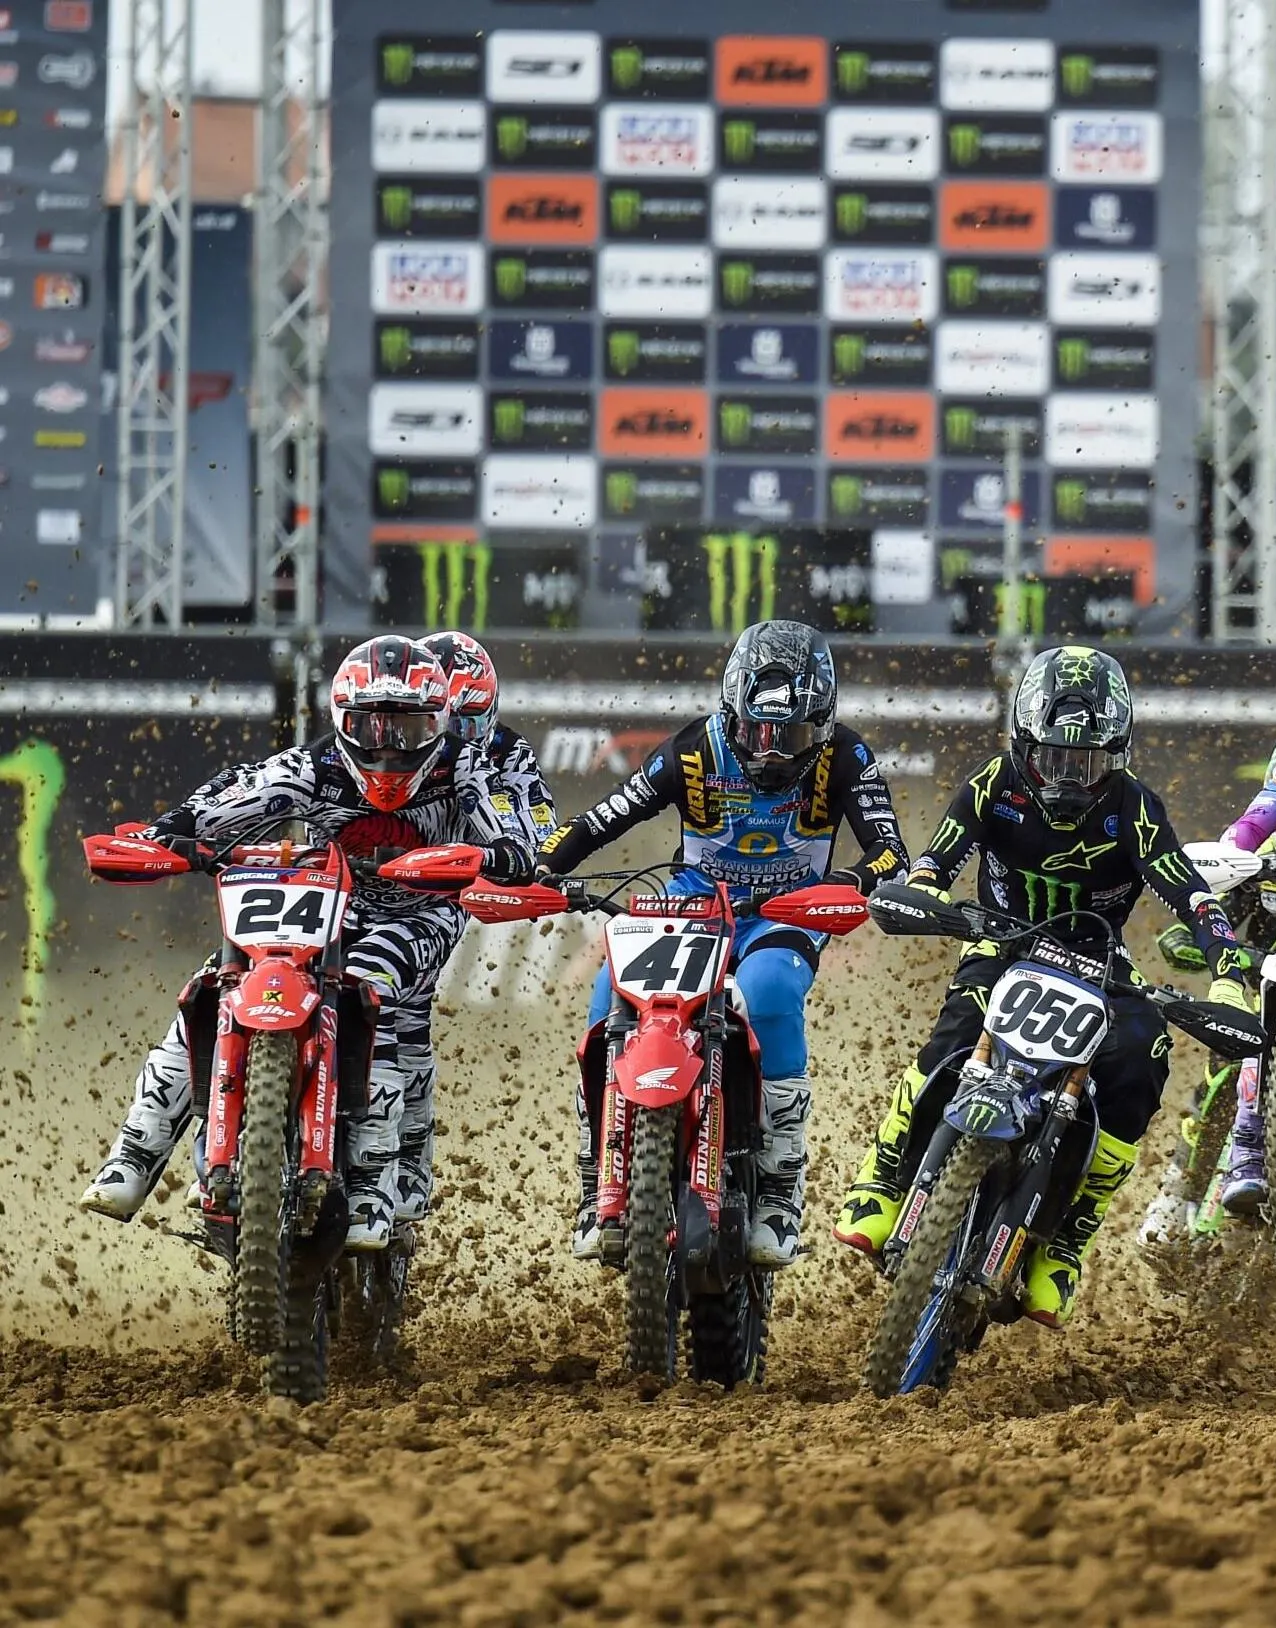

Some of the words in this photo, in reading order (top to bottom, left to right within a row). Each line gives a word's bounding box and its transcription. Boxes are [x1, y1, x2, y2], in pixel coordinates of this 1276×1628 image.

[747, 817, 786, 825] SUMMUS
[144, 861, 172, 870] FIVE
[394, 869, 421, 878] FIVE
[701, 863, 811, 886] CONSTRUCT
[221, 872, 278, 883] HORGMO
[464, 891, 523, 906] ACERBIS
[871, 897, 926, 919] ACERBIS
[235, 888, 325, 937] 24
[805, 905, 865, 916] ACERBIS
[620, 935, 717, 993] 41
[1015, 970, 1043, 981] MXGP
[246, 1005, 297, 1017] Bihr
[990, 979, 1105, 1058] 959
[1205, 1021, 1262, 1046] ACERBIS
[315, 1060, 327, 1124] DUNLOP
[635, 1083, 679, 1092] HONDA
[972, 1091, 1007, 1116] YAMAHA
[901, 1192, 927, 1241] BRAKING
[985, 1226, 1010, 1276] BRAKING
